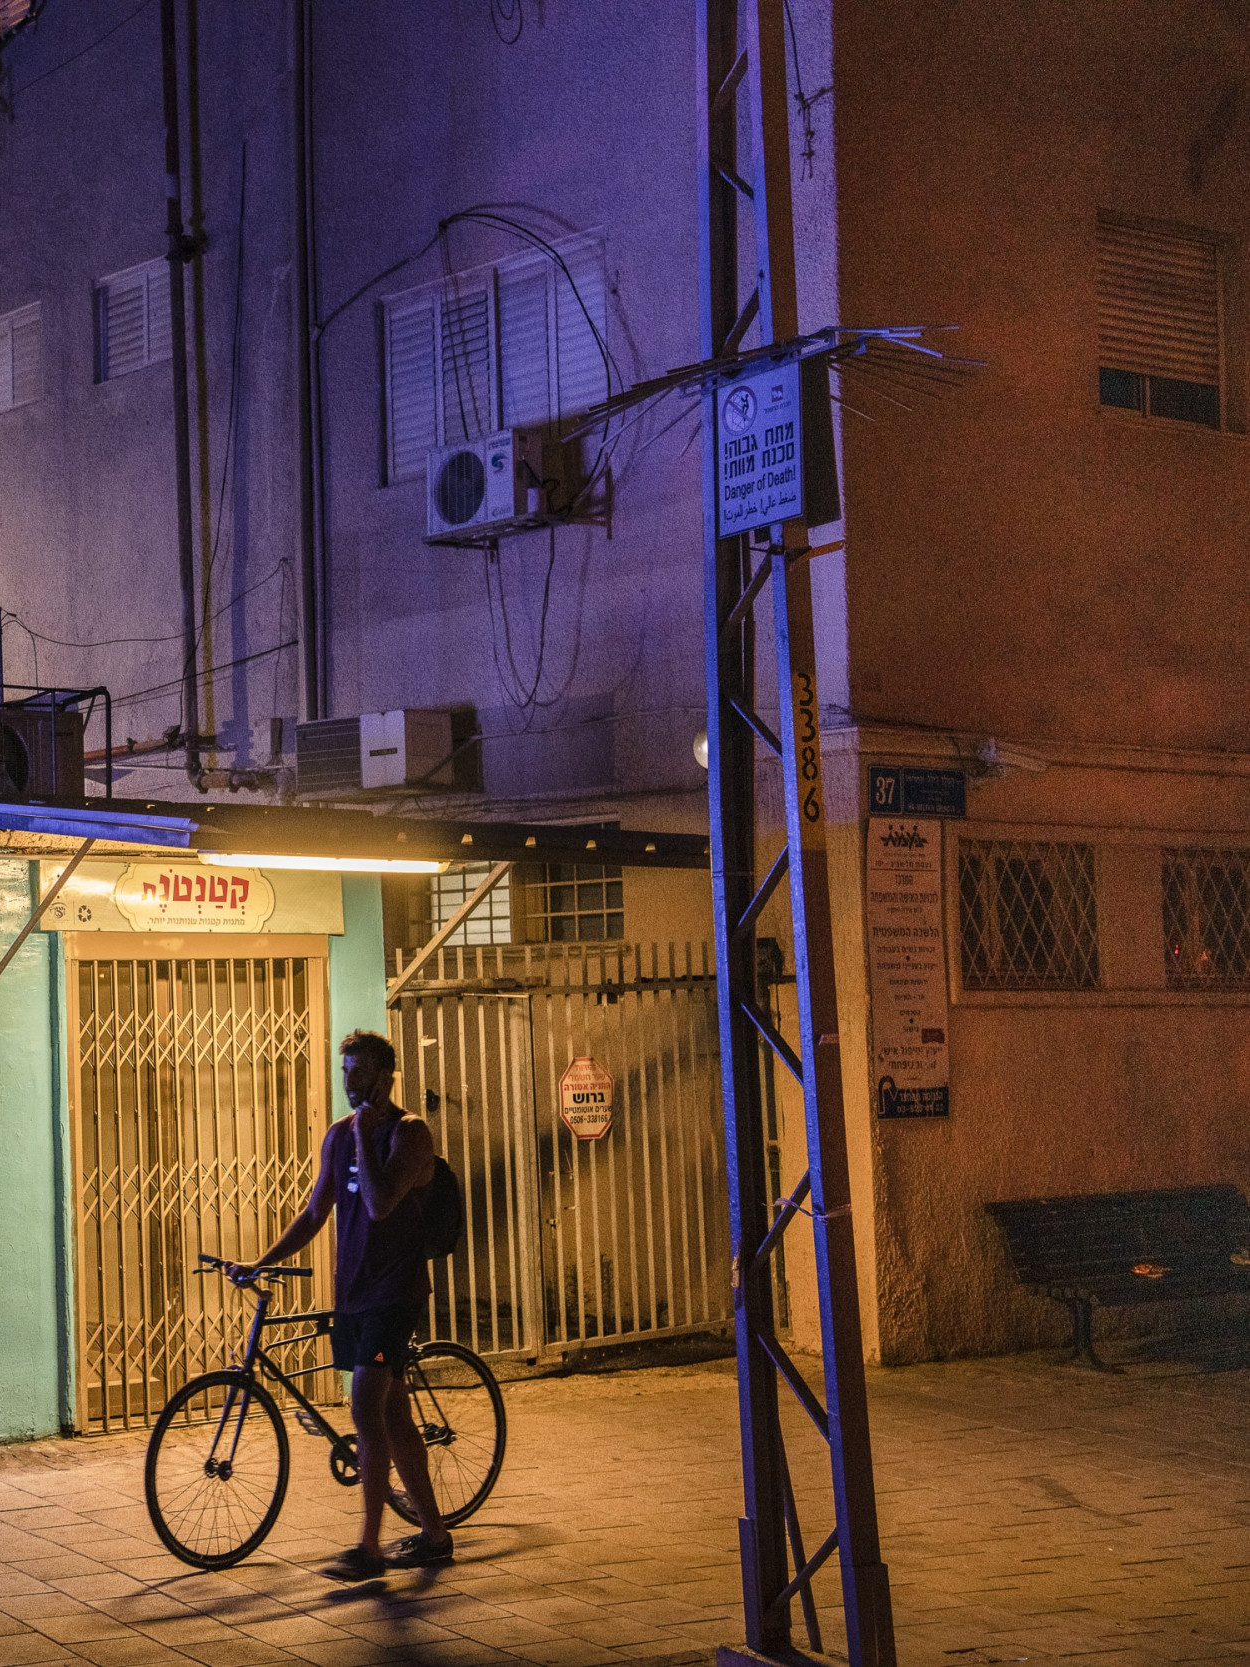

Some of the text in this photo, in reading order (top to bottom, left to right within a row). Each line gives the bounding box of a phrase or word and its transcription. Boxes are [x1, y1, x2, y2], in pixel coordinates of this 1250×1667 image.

[724, 421, 794, 460] מתח גבוה!
[724, 442, 795, 480] סכנת מוות!
[724, 465, 796, 502] Danger of Death!
[797, 672, 820, 823] 3386
[875, 776, 896, 805] 37
[167, 917, 197, 926] שנותנות
[199, 917, 221, 927] קטנות
[223, 917, 245, 926] מתנות
[872, 926, 911, 938] המשפטית
[563, 1082, 611, 1091] החניה אסורה
[572, 1092, 605, 1104] ברוש
[564, 1105, 614, 1114] שערים אוטומטיים
